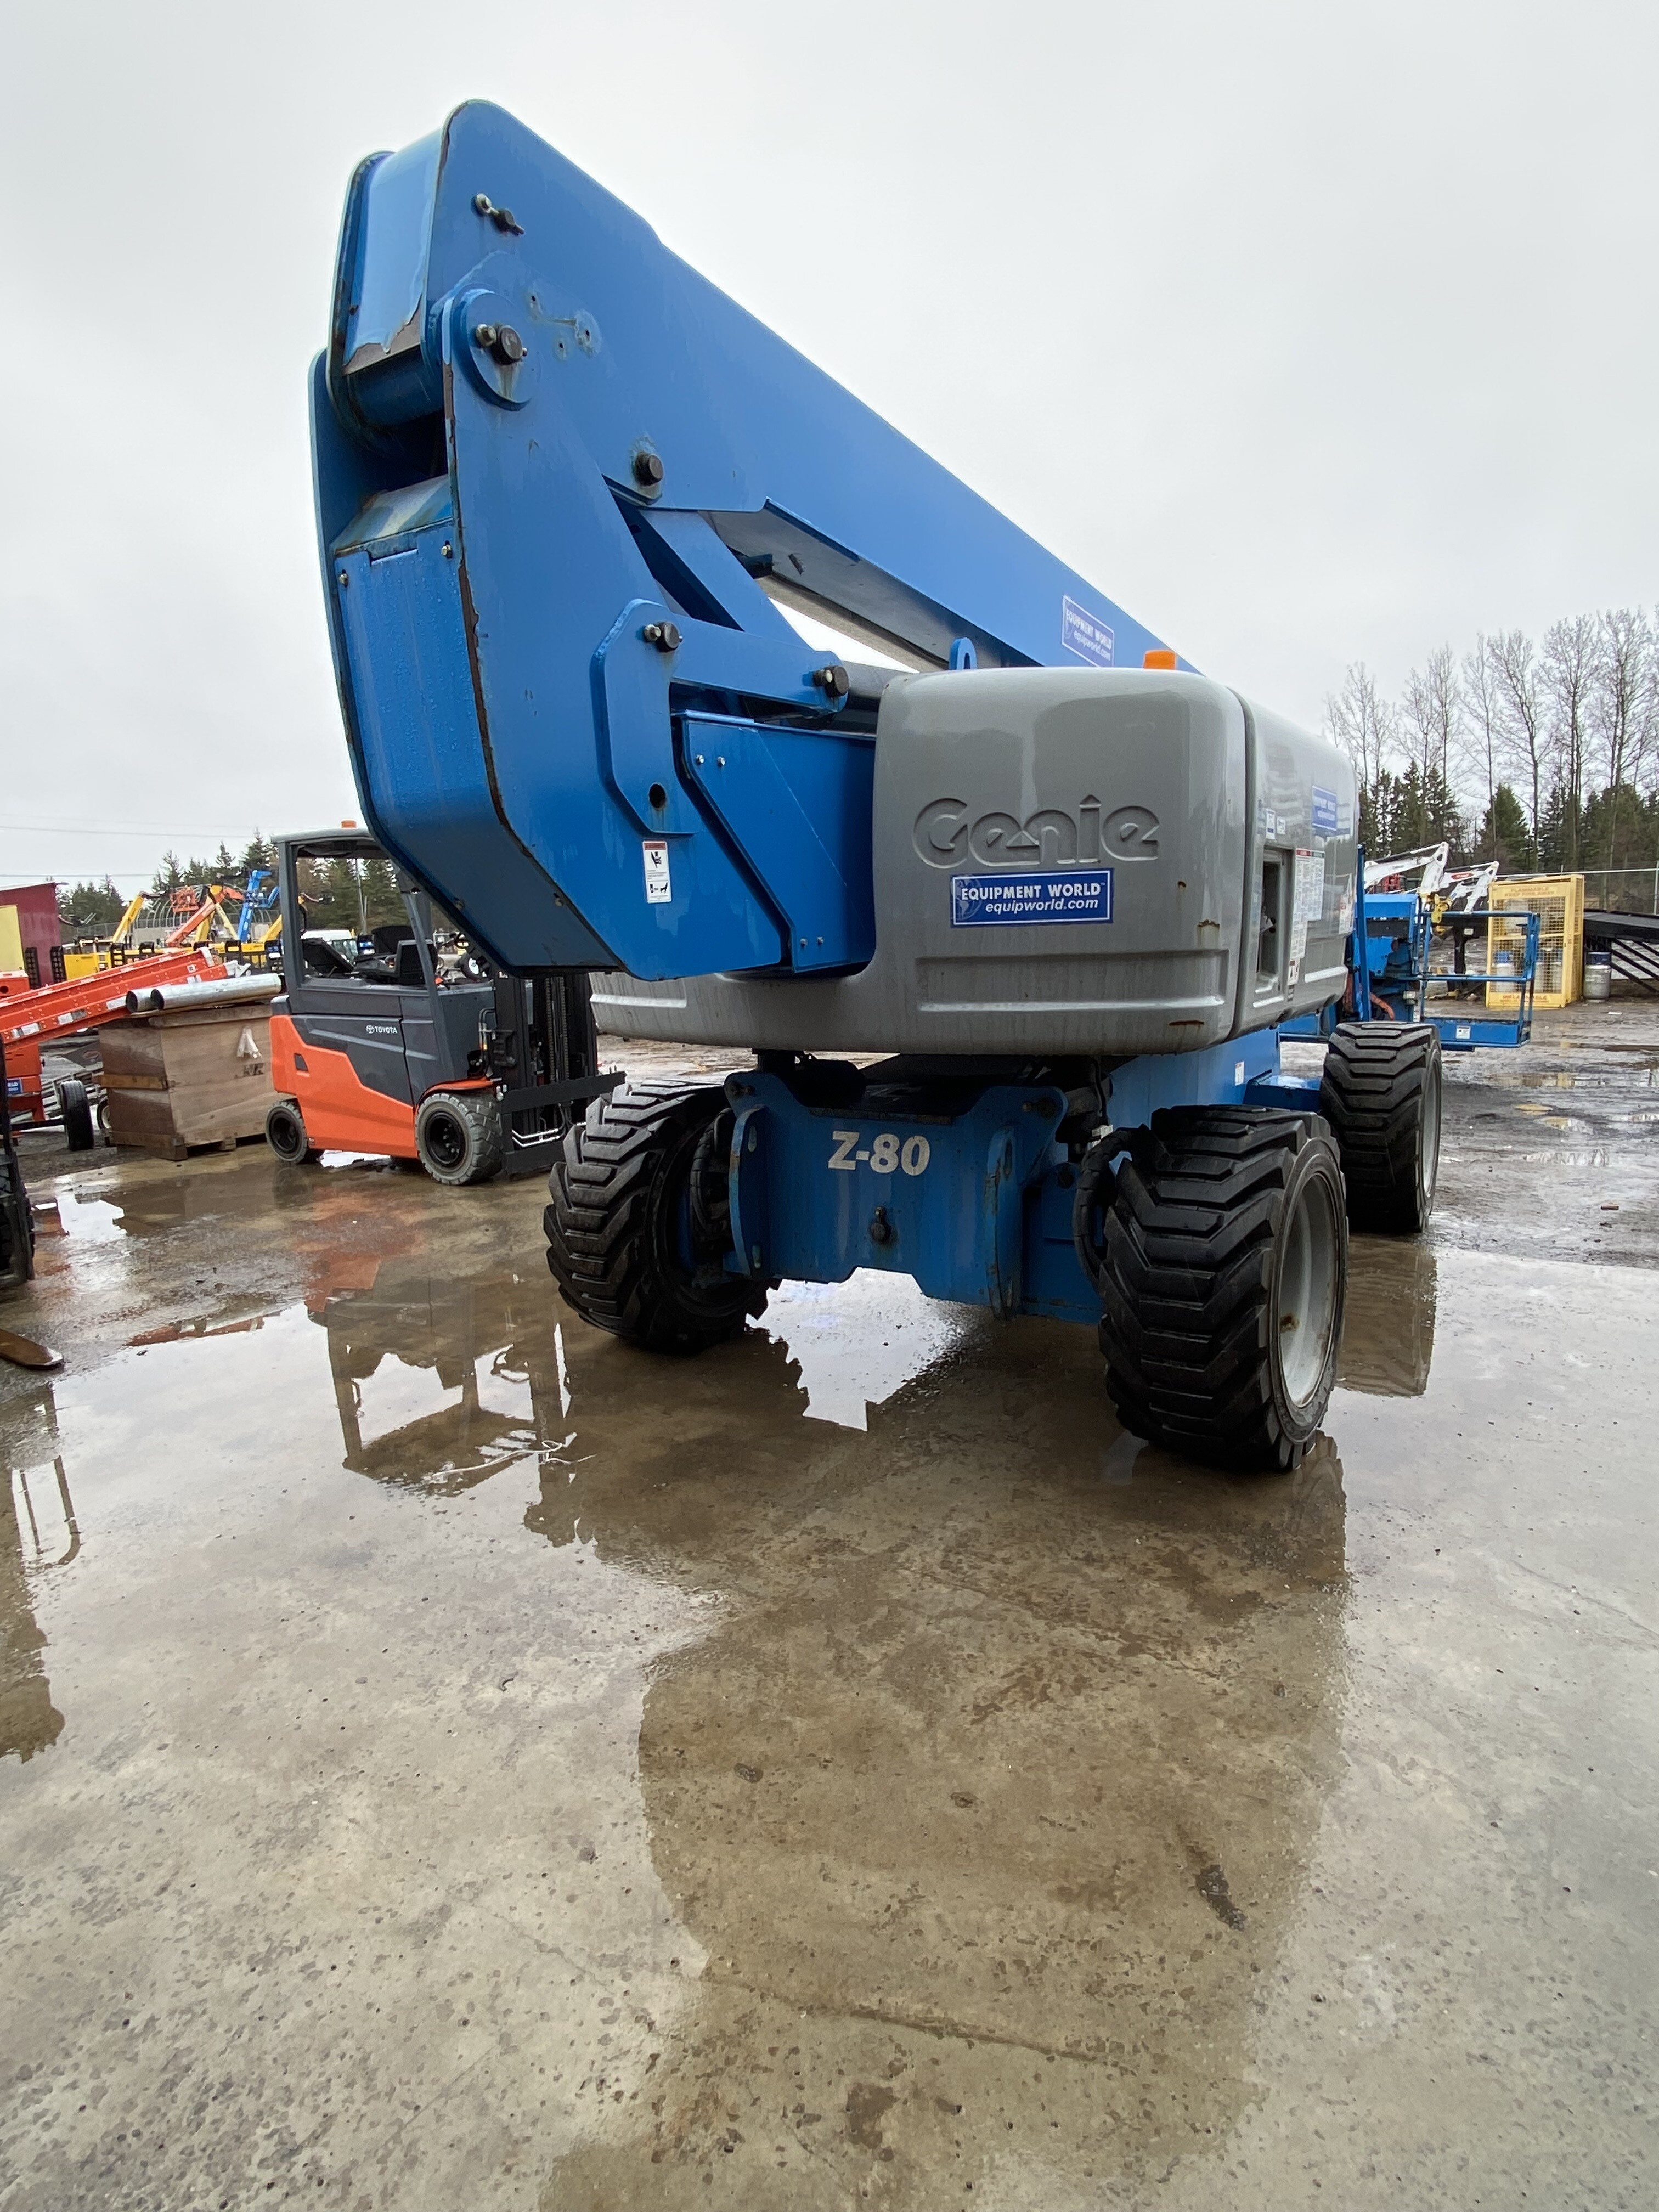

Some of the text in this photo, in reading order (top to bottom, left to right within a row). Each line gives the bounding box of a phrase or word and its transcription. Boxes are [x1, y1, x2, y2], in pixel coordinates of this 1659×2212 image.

[1066, 608, 1111, 650] EQUIPMENT WORLD
[1074, 630, 1111, 661] equipworld.com
[913, 794, 1160, 868] Genie
[961, 883, 1101, 901] EQUIPMENT WORLD
[985, 898, 1099, 915] equipworld.com
[828, 1130, 930, 1176] Z-80
